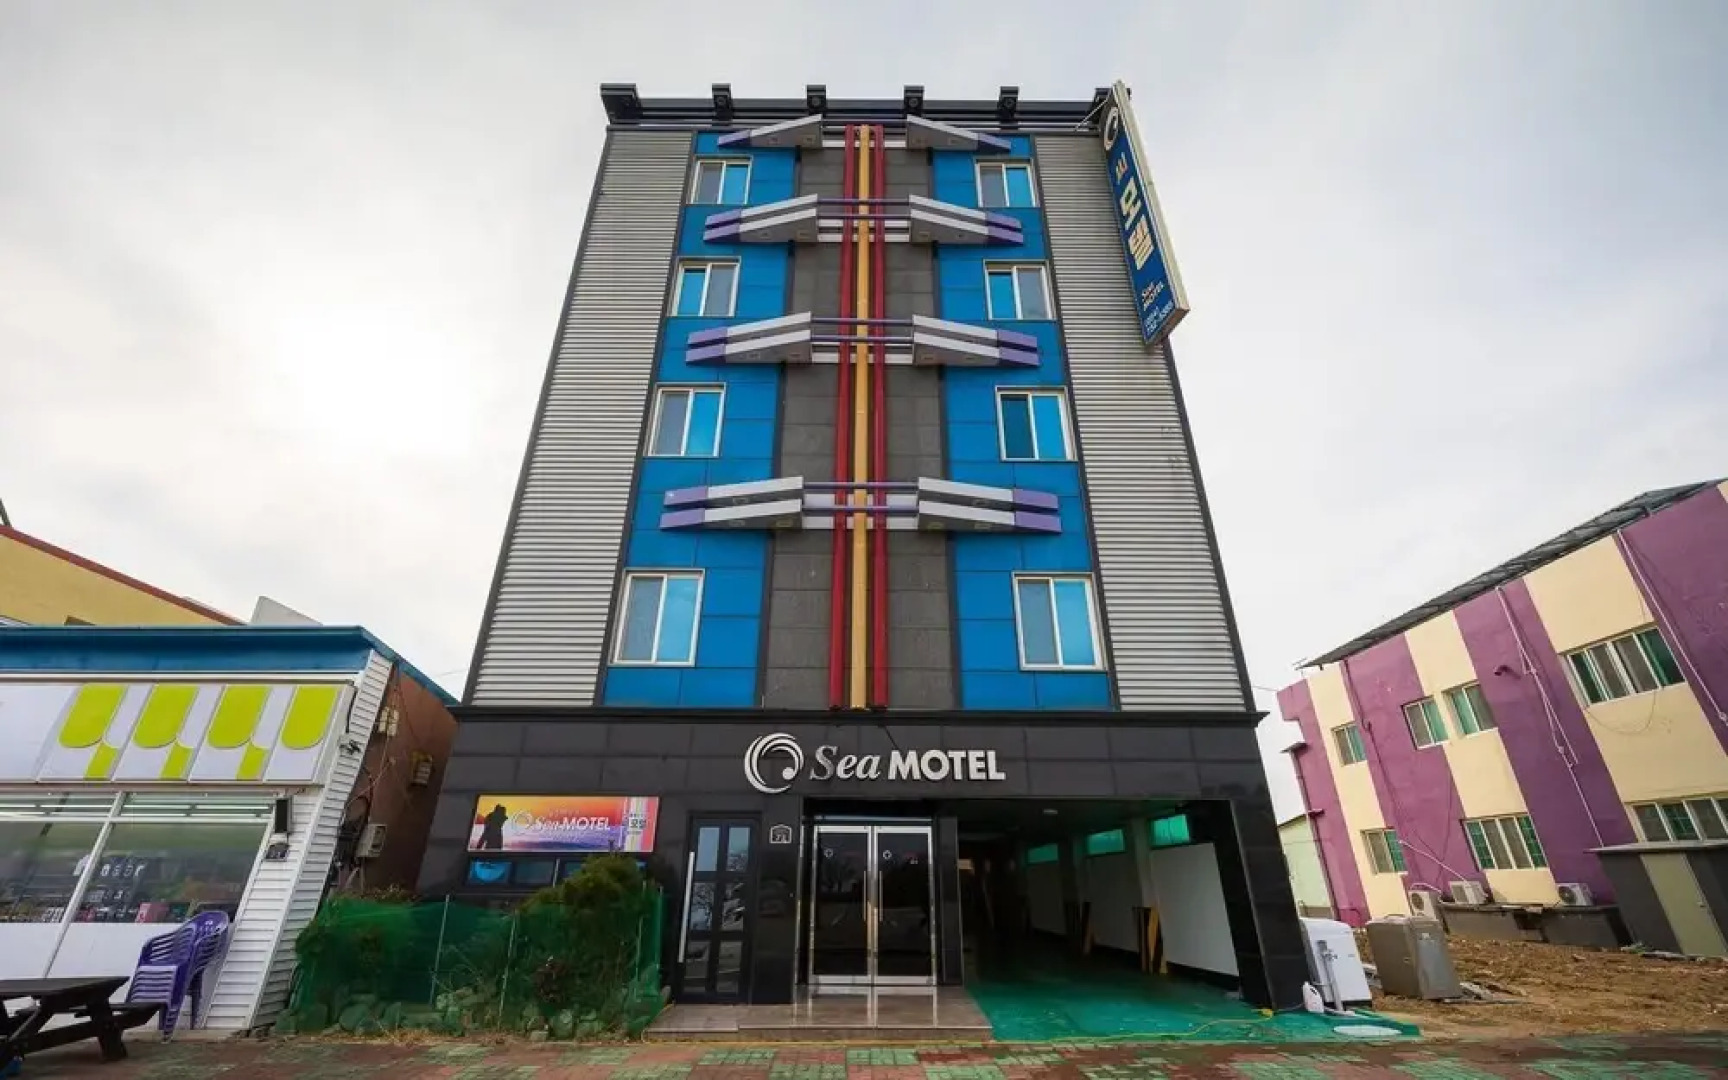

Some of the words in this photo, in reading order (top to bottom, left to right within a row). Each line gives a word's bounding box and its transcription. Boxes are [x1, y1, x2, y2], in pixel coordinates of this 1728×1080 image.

[809, 744, 882, 781] Sea
[887, 748, 1007, 781] MOTEL
[562, 816, 611, 831] MOTEL
